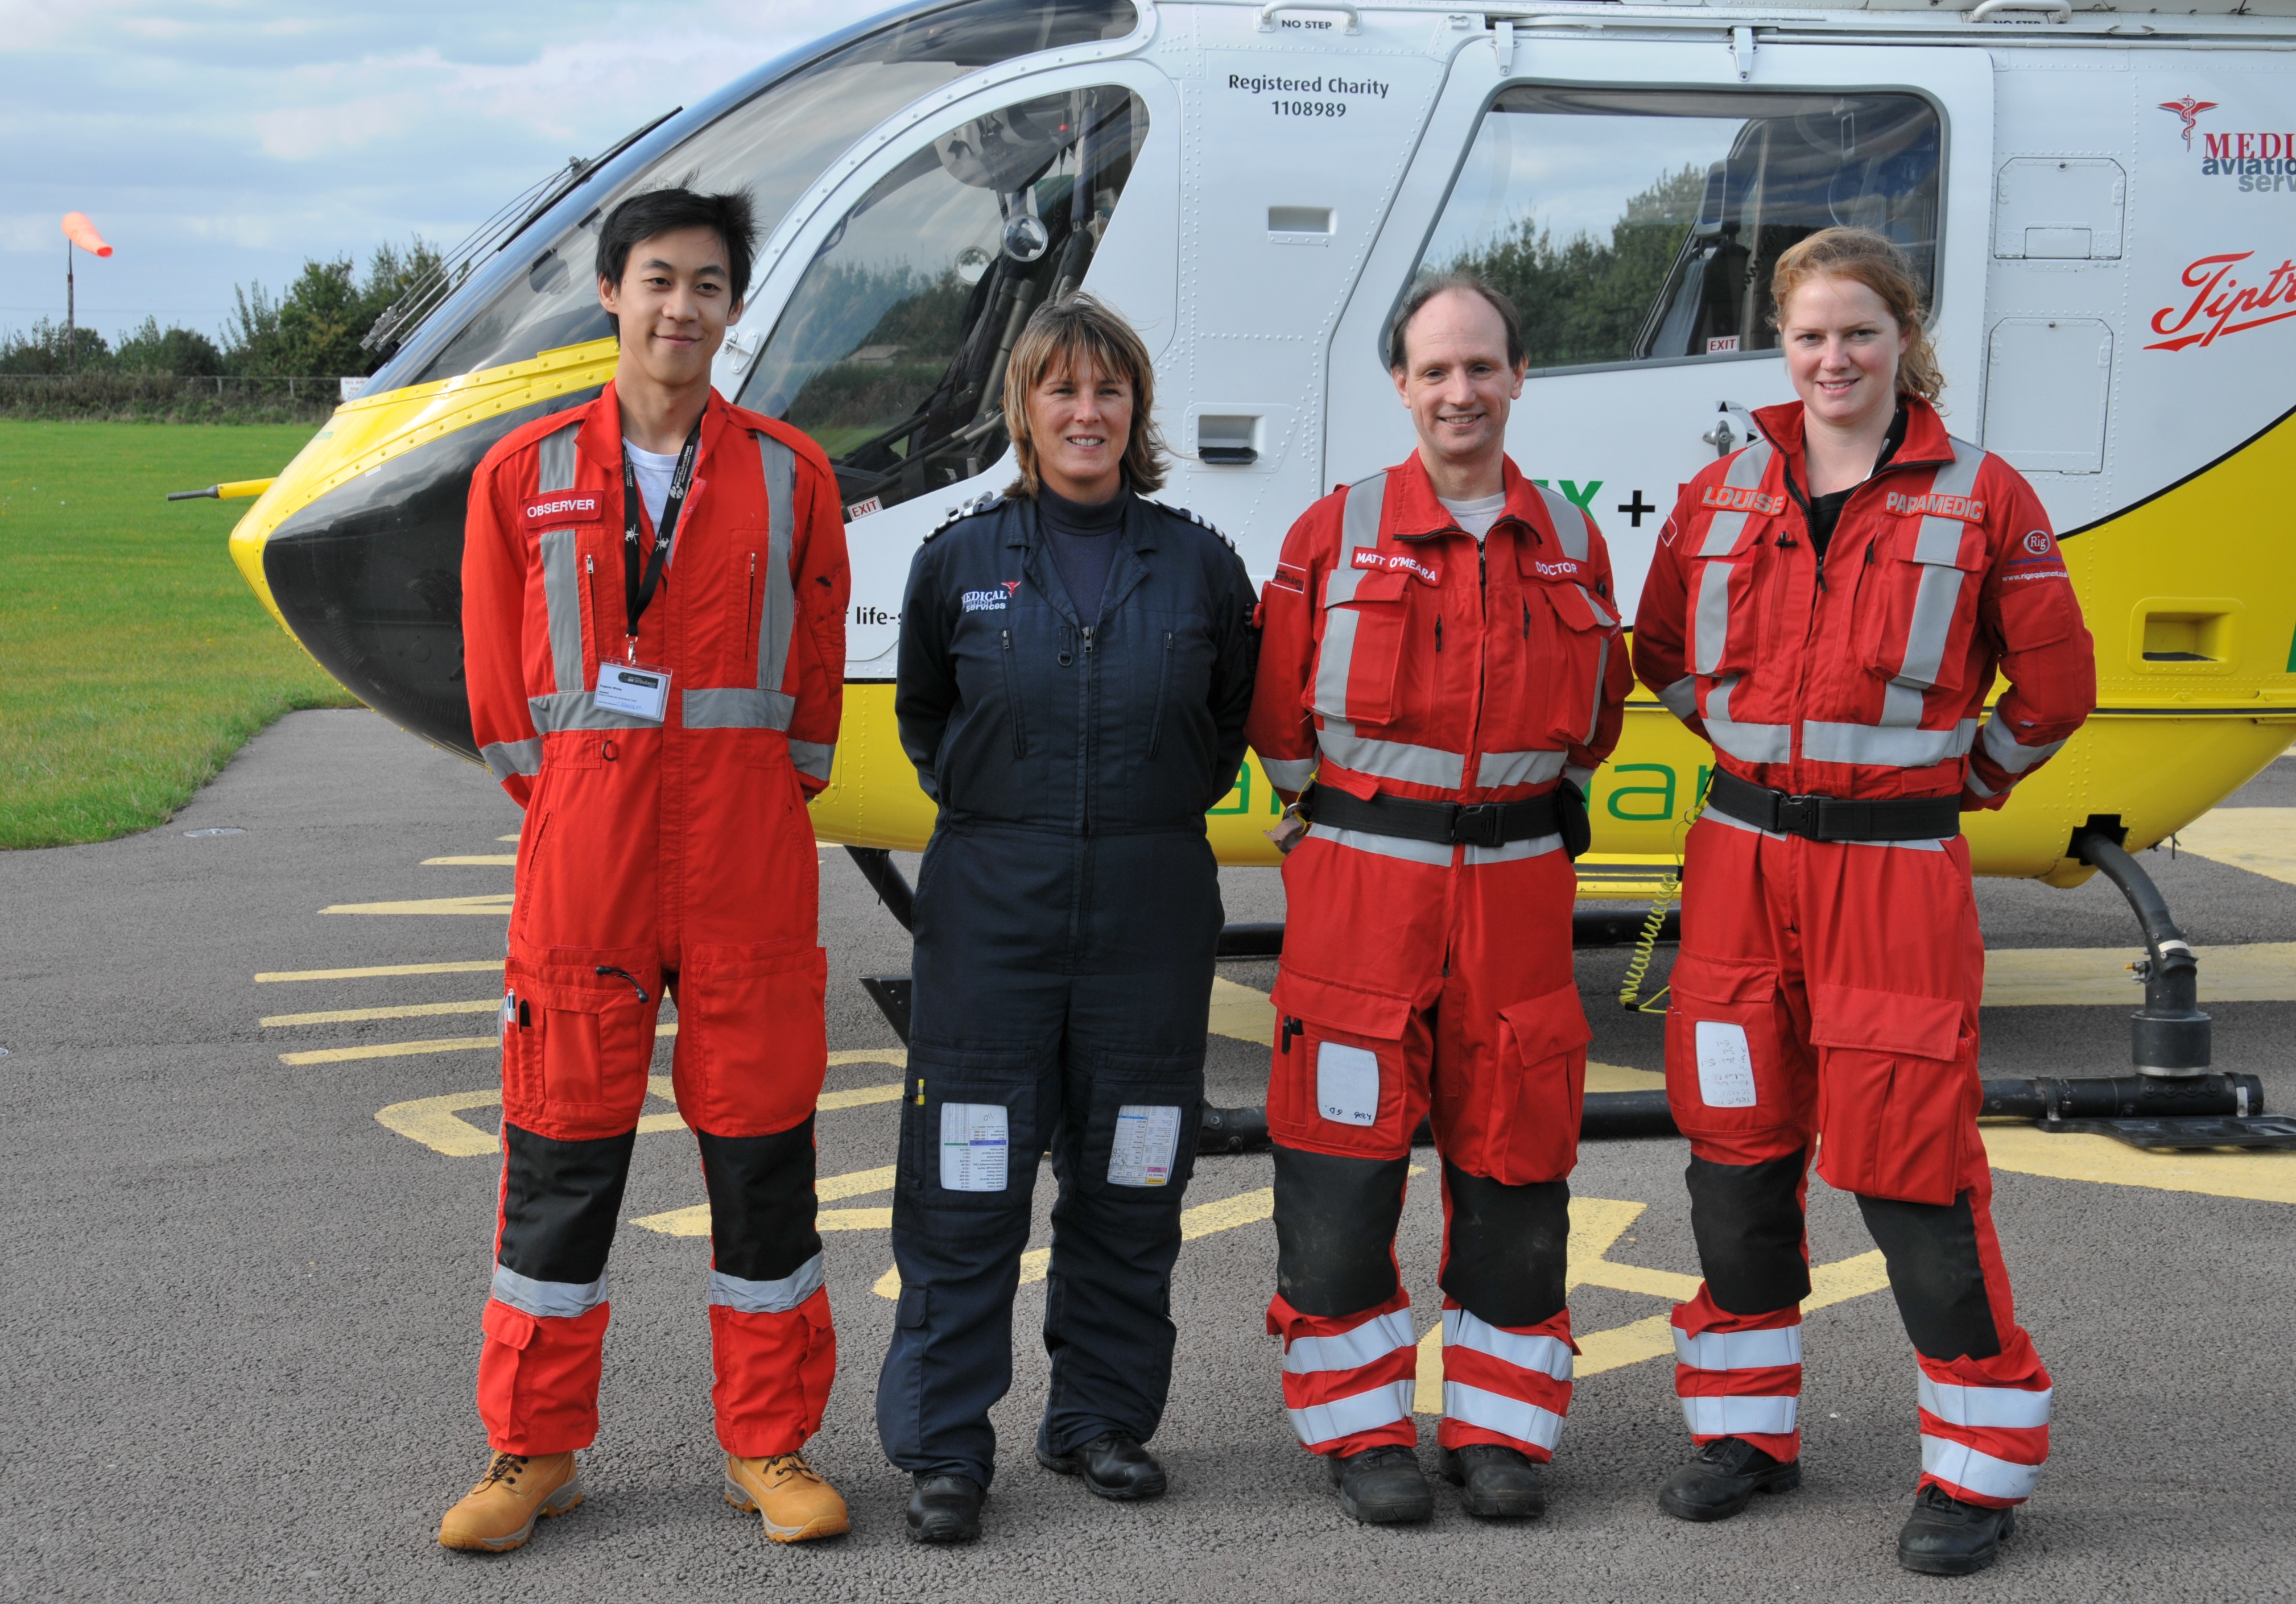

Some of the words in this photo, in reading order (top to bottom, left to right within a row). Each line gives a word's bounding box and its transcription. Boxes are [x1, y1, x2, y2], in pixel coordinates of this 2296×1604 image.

[1281, 19, 1301, 29] NO
[1304, 20, 1332, 30] STEP
[1228, 75, 1322, 94] Registered
[1328, 78, 1389, 98] Charity
[1271, 101, 1347, 117] 1108989
[1710, 338, 1736, 351] EXIT
[527, 499, 595, 518] OBSERVER
[852, 499, 877, 518] EXIT
[1703, 486, 1784, 514] LOUISE
[1887, 491, 1984, 519] PARAMEDIC
[2030, 535, 2046, 551] Rig
[1356, 552, 1386, 566] MATT
[1389, 557, 1436, 582] O'MEARA
[1535, 561, 1577, 577] DOCTOR
[966, 602, 1006, 613] services
